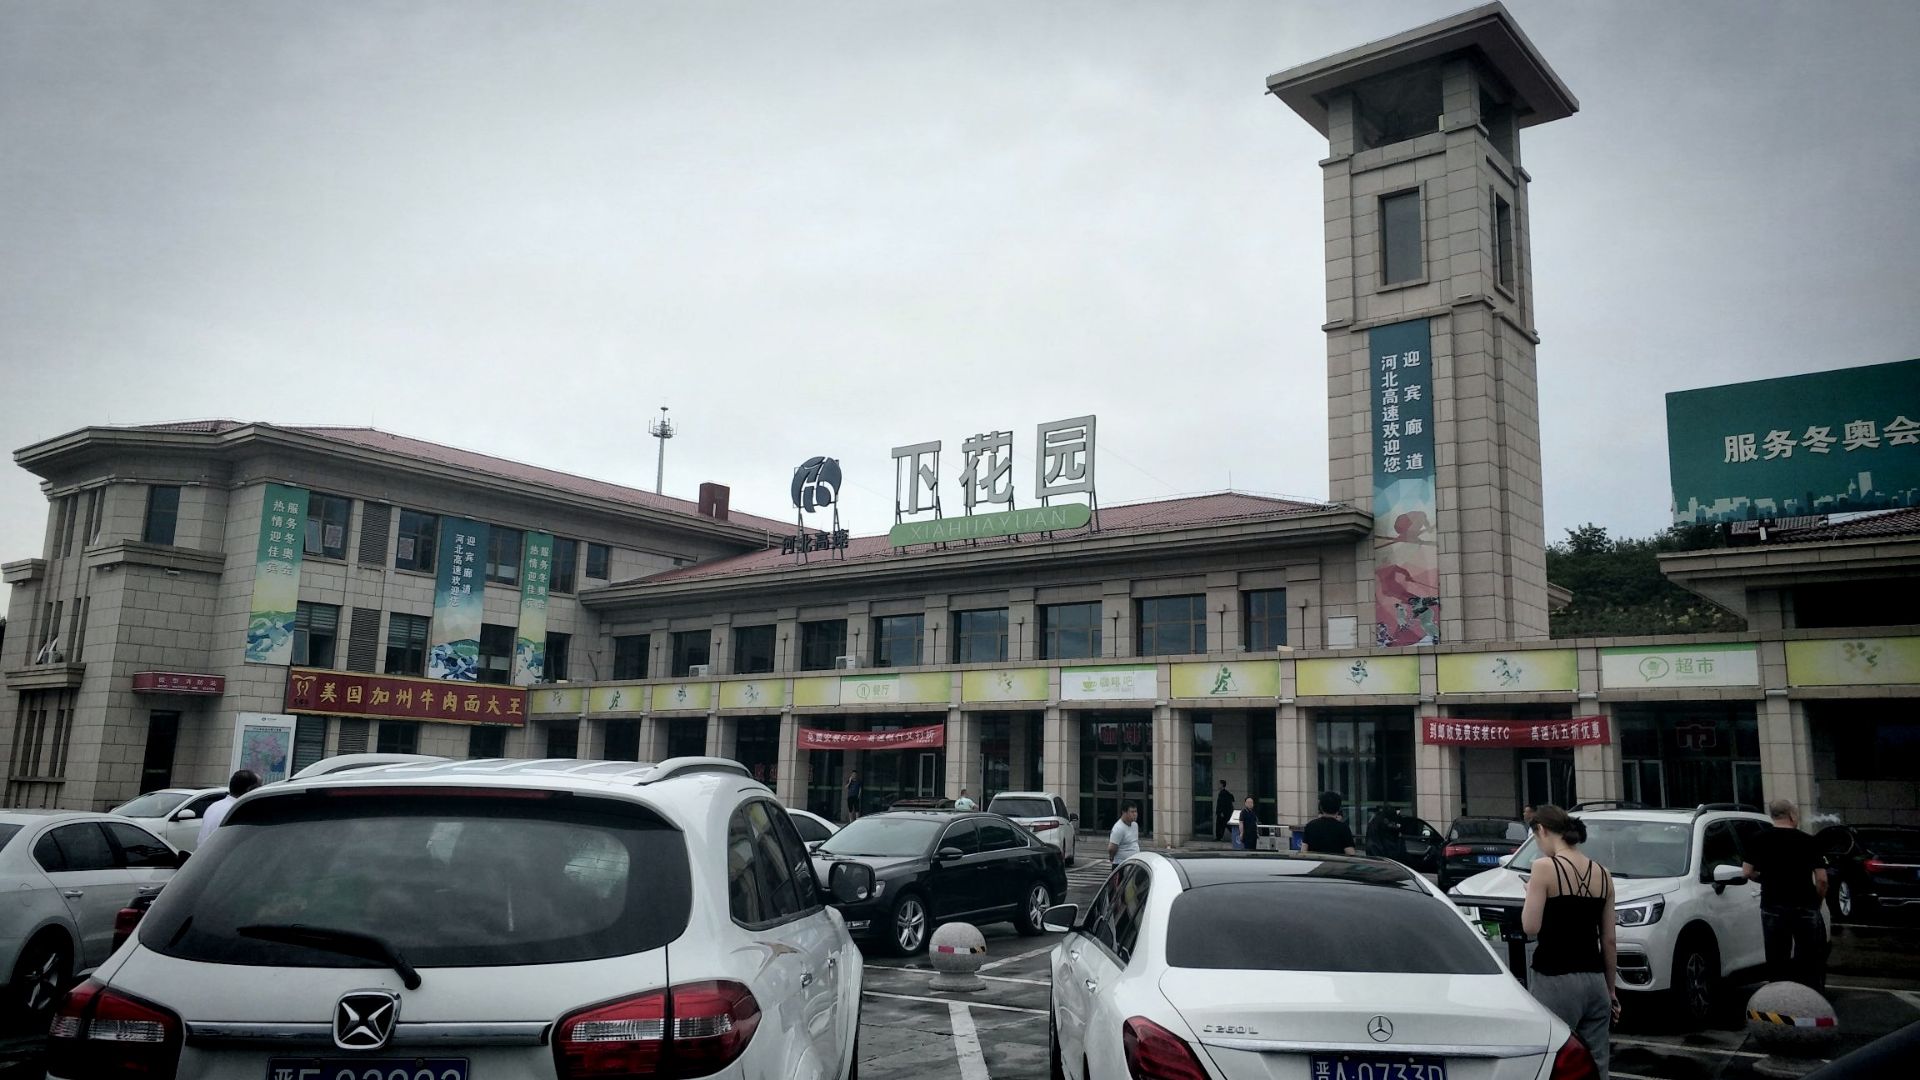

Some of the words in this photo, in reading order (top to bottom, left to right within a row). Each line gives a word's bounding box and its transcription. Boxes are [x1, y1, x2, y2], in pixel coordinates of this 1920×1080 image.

[1380, 354, 1402, 474] 河北高速欢迎您
[1403, 350, 1425, 471] 迎宾廊道
[1723, 415, 1920, 464] 服务冬奥会
[890, 414, 1097, 515] 下花园
[266, 499, 286, 574] 热情迎佳宾
[281, 502, 300, 576] 服务冬奥会
[910, 508, 1068, 540] XIAHUAYUAN
[448, 533, 465, 608] 河北高速欢迎您
[462, 534, 477, 595] 迎宾廊道
[319, 681, 524, 717] 美国加州牛肉面大王
[1675, 656, 1715, 675] 超市
